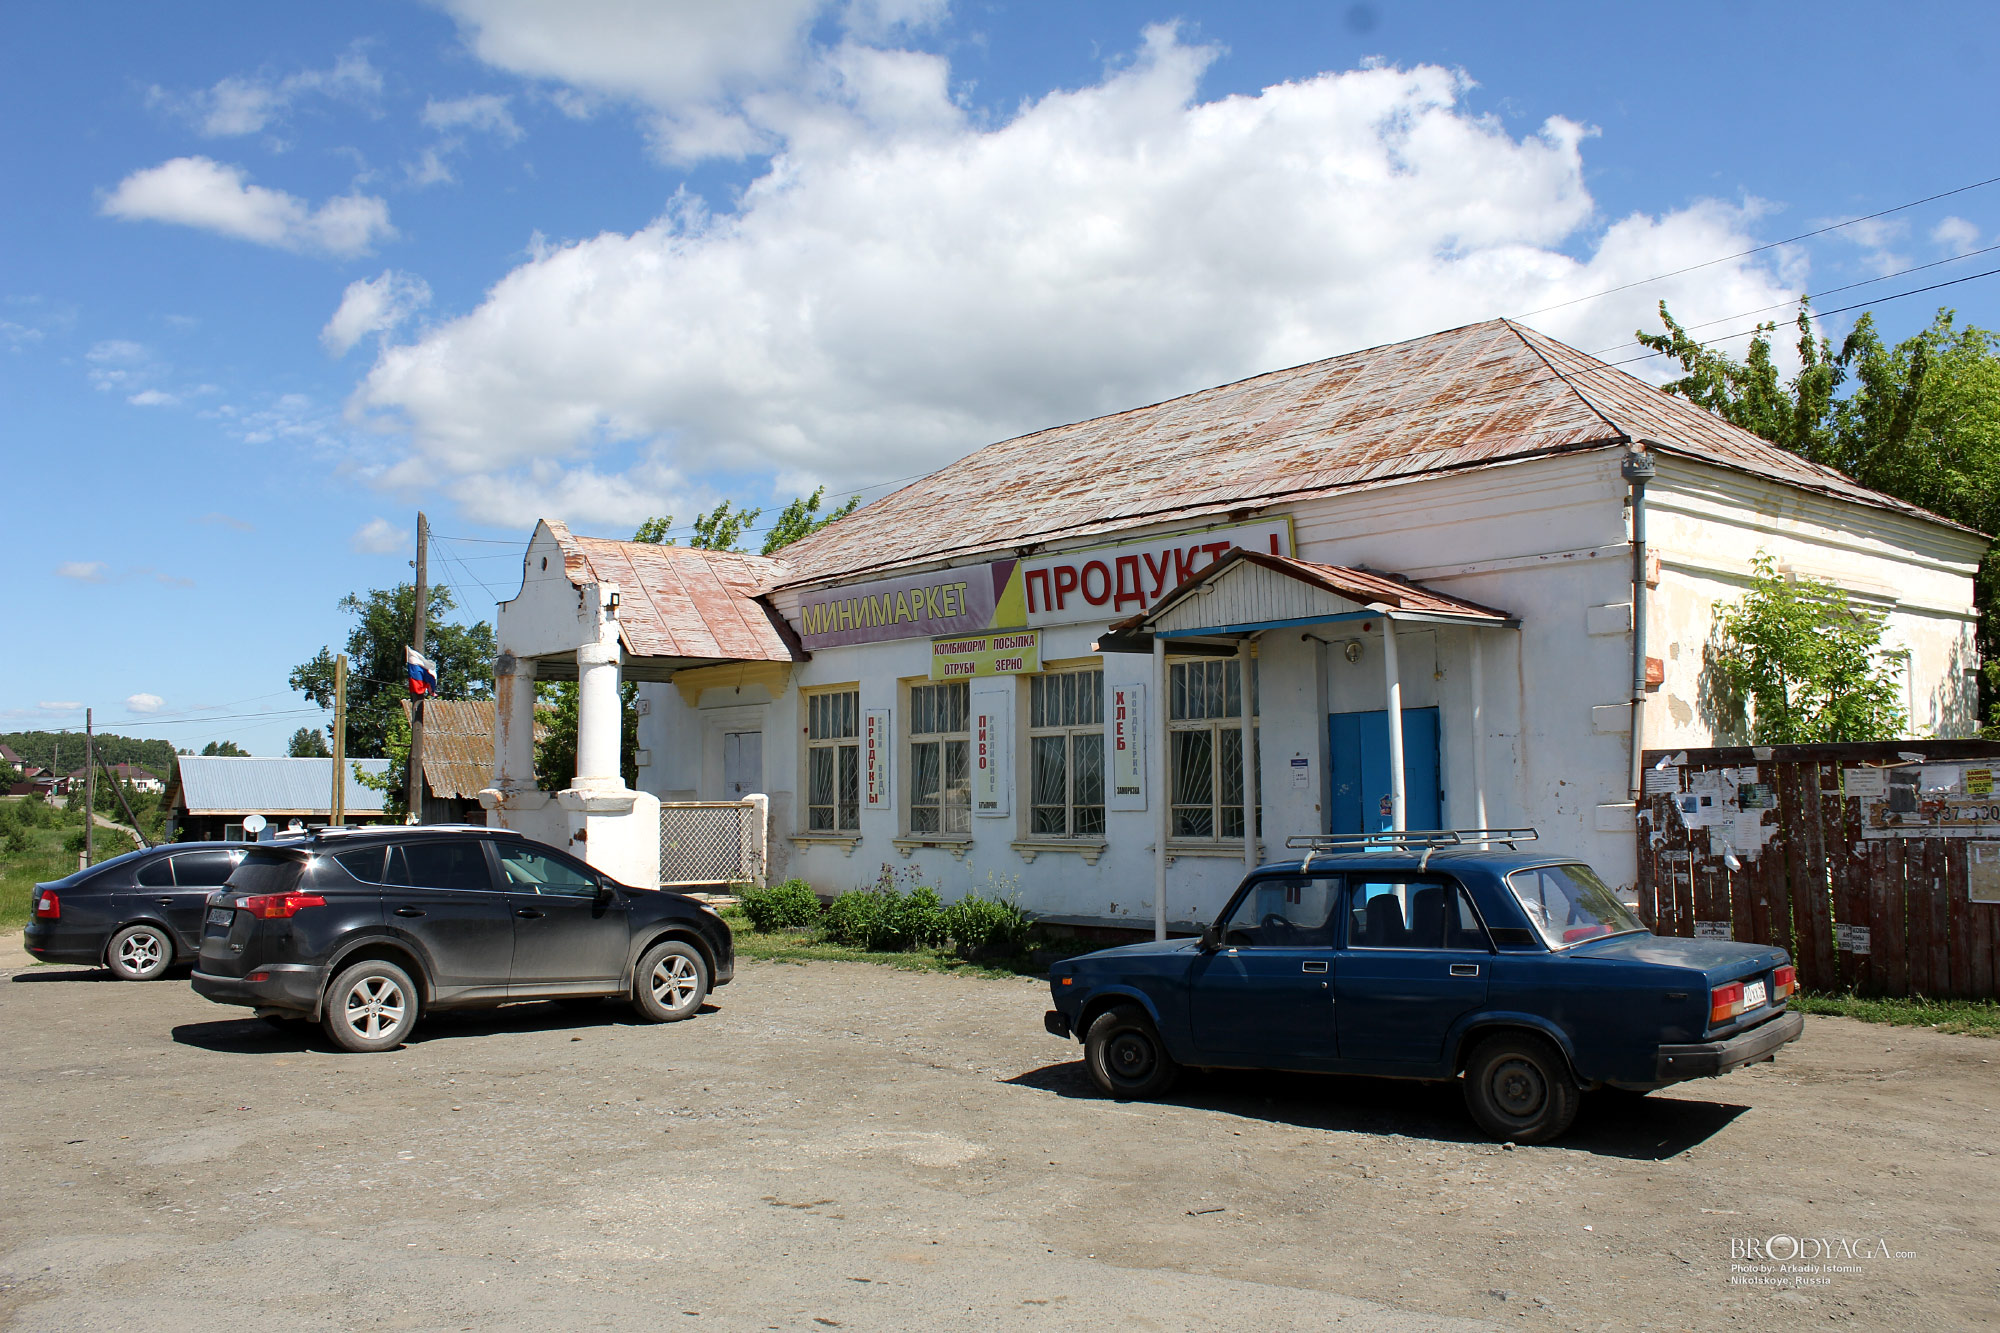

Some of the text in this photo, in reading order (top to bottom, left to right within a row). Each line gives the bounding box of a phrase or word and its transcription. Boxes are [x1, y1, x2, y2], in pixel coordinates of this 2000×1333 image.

[1025, 534, 1279, 613] ПРОДУКТ
[802, 582, 967, 636] МИНИМАРКЕТ
[934, 635, 1035, 656] КОМБИКОРМ ПОСЫПКА
[944, 658, 1023, 676] ОТРУБИ ЗЕРНО
[978, 715, 987, 770] ПИВО
[1116, 691, 1126, 751] ХЛЕБ
[868, 716, 878, 803] ПРОДУКТЫ
